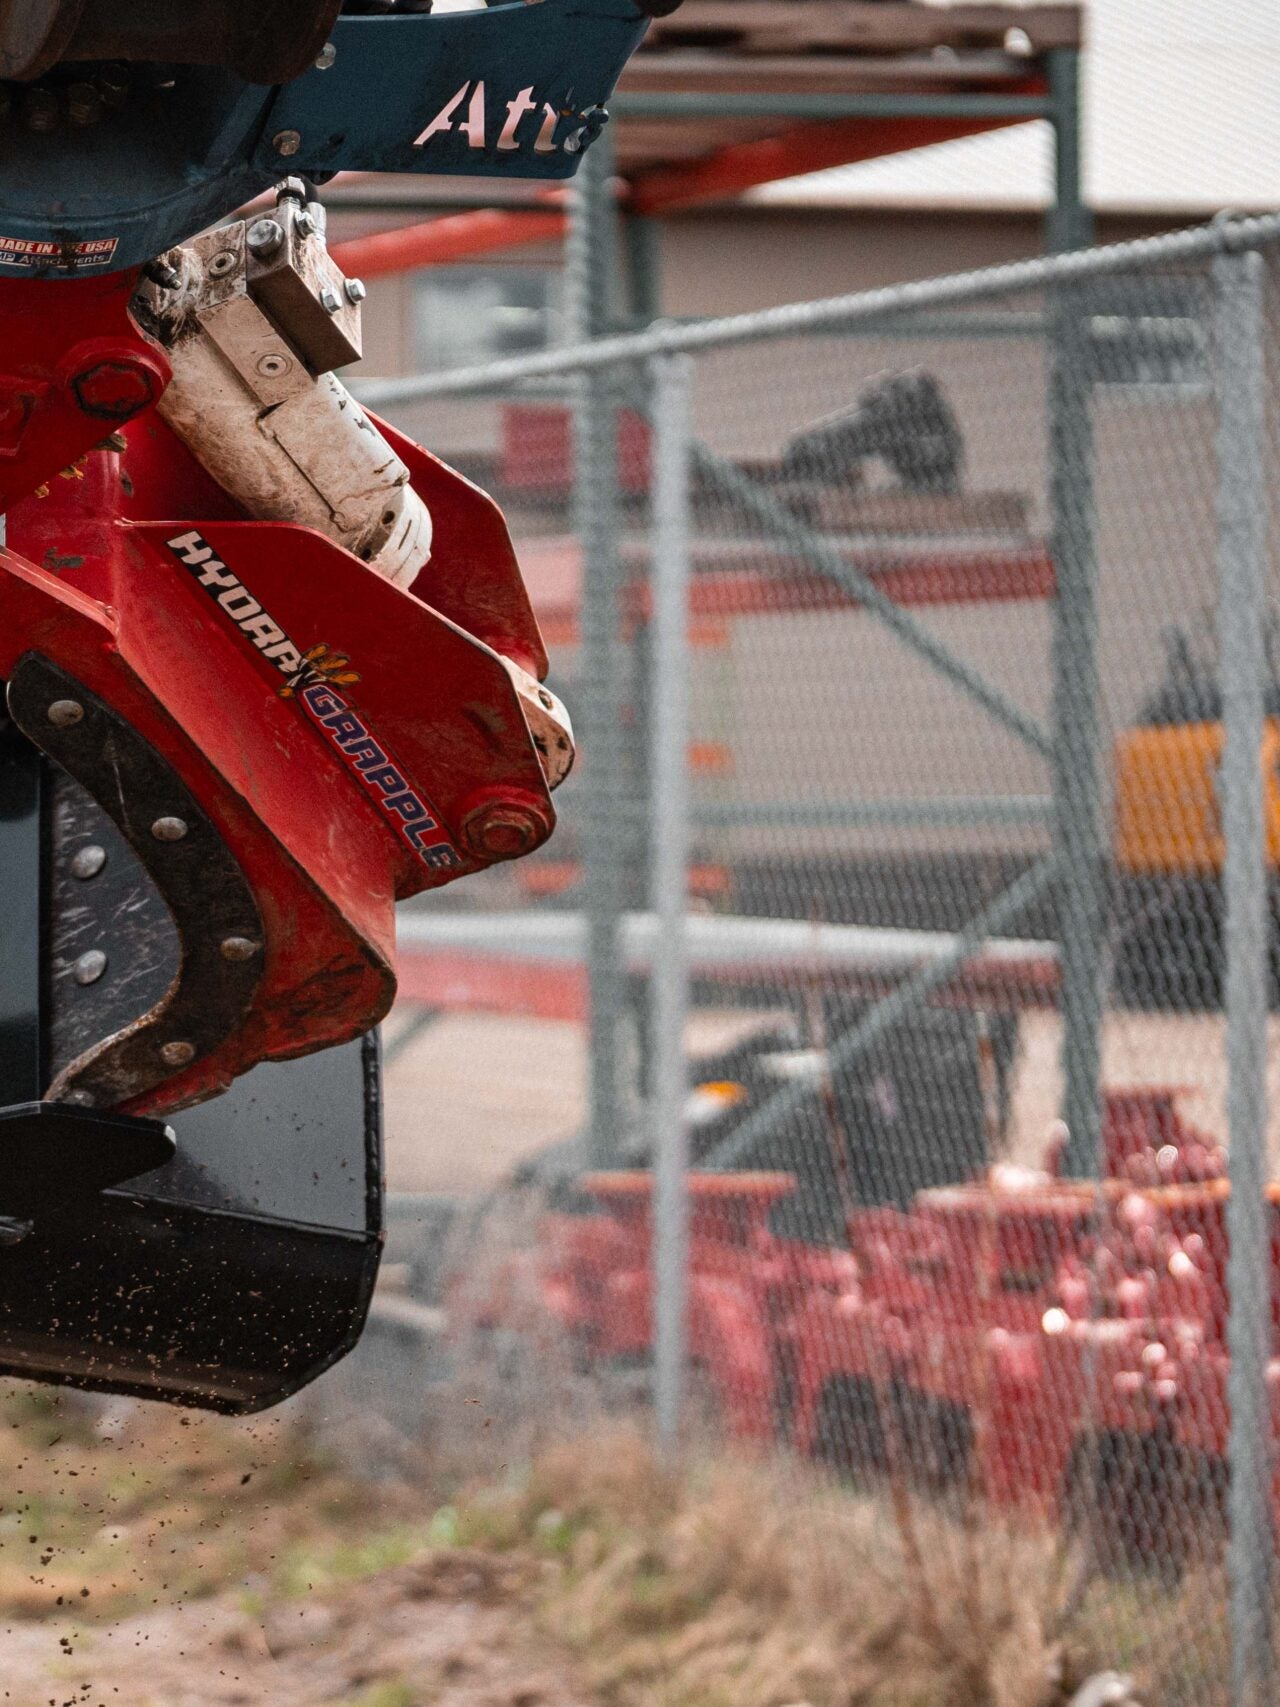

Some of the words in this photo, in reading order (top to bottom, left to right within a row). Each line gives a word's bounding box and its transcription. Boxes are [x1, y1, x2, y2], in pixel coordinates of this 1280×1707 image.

[18, 254, 105, 266] Attcents
[36, 243, 54, 254] IN
[86, 241, 114, 253] USA
[168, 531, 303, 673] HYDRA
[303, 684, 466, 869] GRAPPLE
